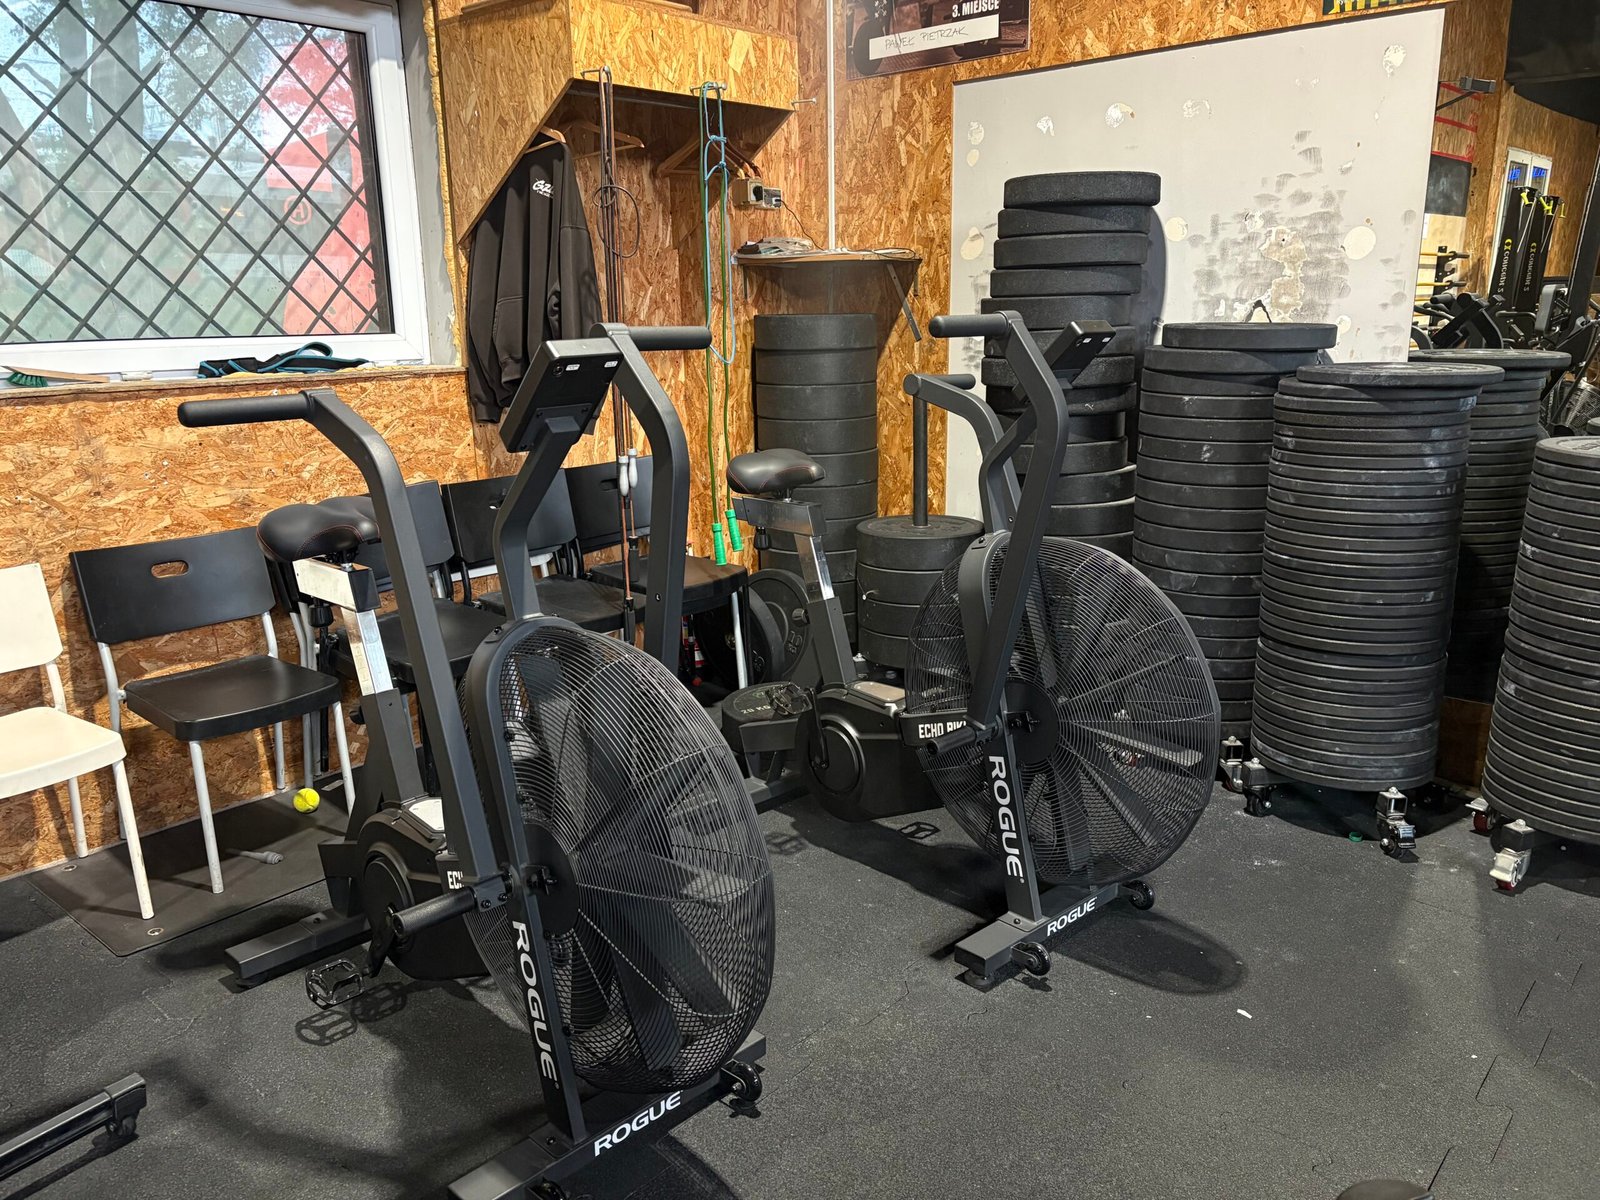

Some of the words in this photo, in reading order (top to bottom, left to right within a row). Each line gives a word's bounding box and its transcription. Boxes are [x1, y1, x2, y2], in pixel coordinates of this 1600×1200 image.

[952, 4, 961, 18] 3.
[961, 0, 1000, 16] MIEJSCE
[920, 26, 969, 42] PIETRZAK
[918, 722, 944, 739] ECHO
[988, 756, 1024, 878] ROGUE
[1047, 896, 1097, 937] ROGUE
[512, 920, 559, 1083] ROGUE
[594, 1090, 682, 1157] ROGUE
